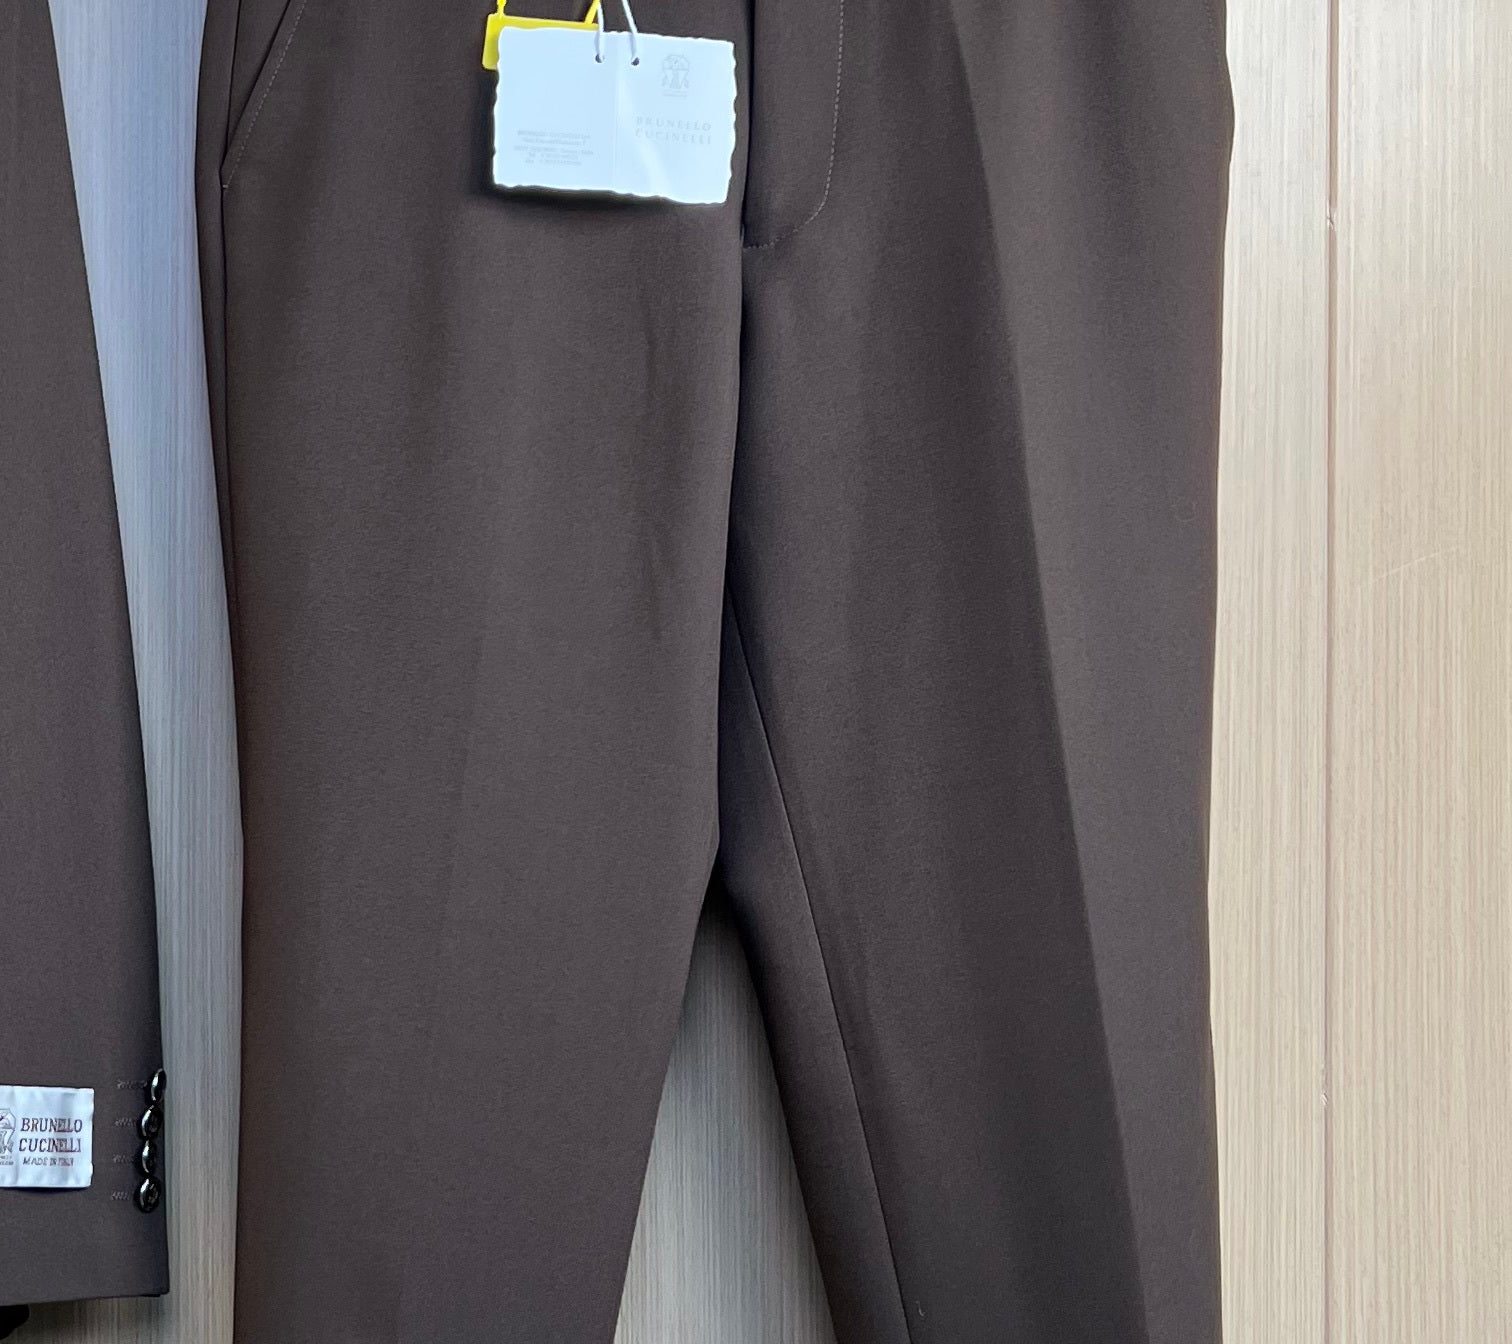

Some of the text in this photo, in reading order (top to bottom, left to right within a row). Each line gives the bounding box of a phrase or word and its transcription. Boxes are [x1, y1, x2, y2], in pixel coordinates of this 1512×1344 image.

[636, 116, 712, 132] BRUNELLO
[20, 1117, 83, 1133] BRUNELLO
[18, 1137, 82, 1153] CUCINELLI
[22, 1157, 48, 1166] MADE
